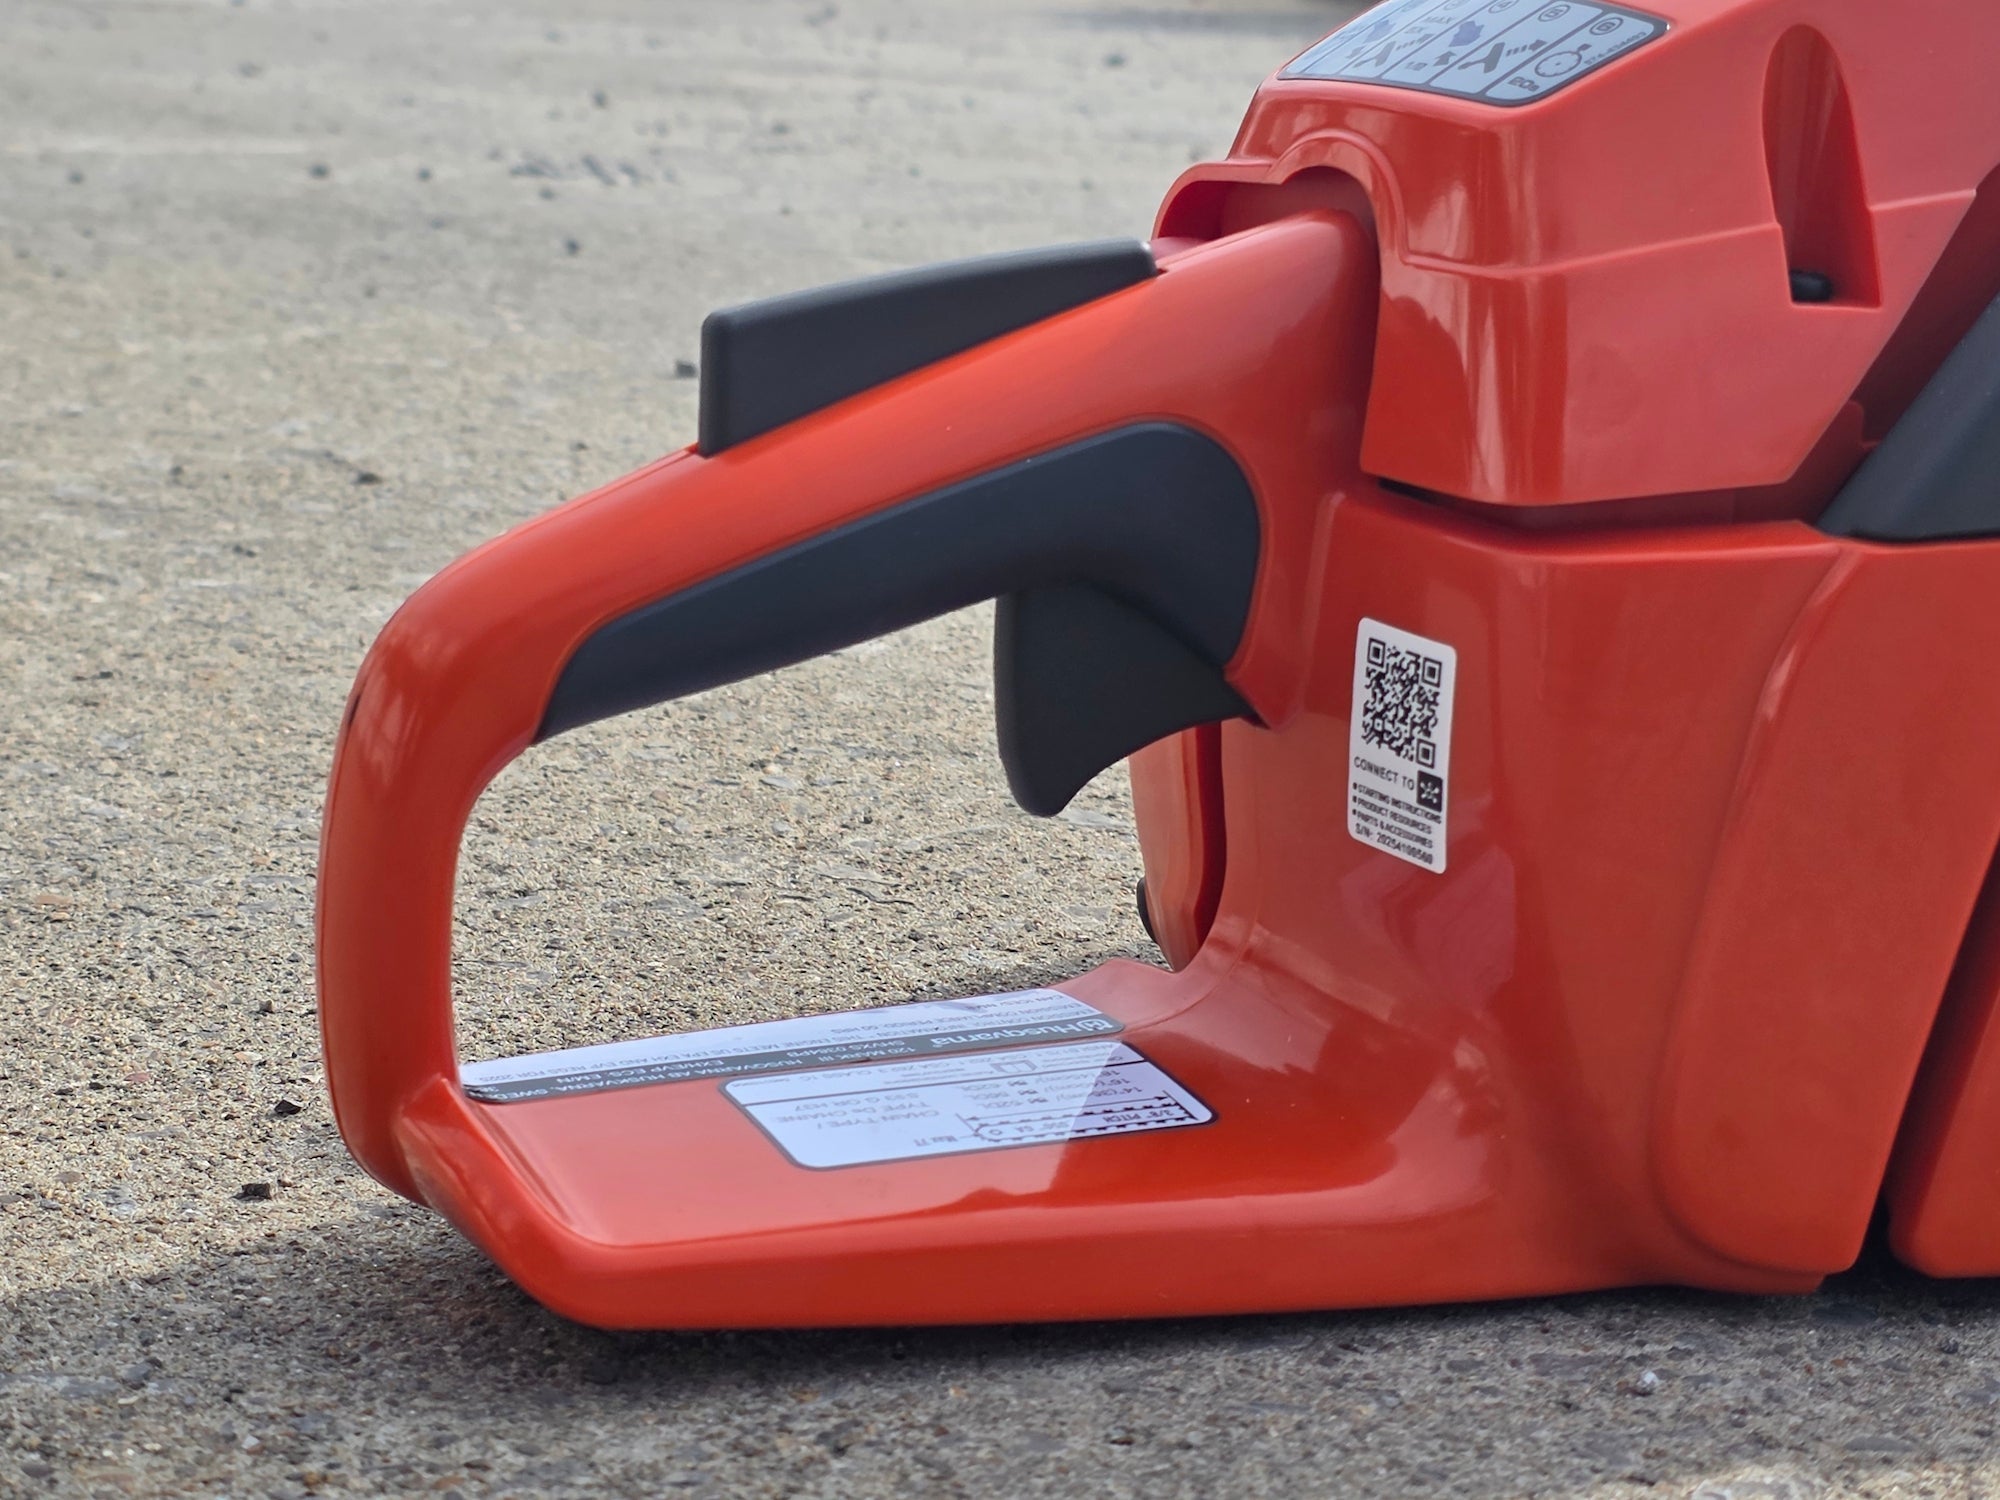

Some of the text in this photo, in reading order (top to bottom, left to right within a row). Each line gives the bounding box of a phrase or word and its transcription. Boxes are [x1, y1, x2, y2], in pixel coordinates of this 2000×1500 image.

[1354, 756, 1415, 791] CONNECT TO
[1358, 784, 1442, 824] STARTING INSTRUCTIONS
[1357, 797, 1432, 835] PRODUCT RESOURCES
[1357, 810, 1379, 827] PARTS
[934, 1023, 1081, 1045] Husqvarna
[833, 1049, 887, 1059] MARK
[884, 1046, 917, 1054] 120
[693, 1058, 803, 1075] HUSQVARNA
[883, 1101, 929, 1110] TYPE
[773, 1110, 849, 1122] CHAINE
[878, 1110, 941, 1121] CHAIN
[1100, 1113, 1143, 1122] PITCH
[824, 1117, 877, 1128] TYPE
